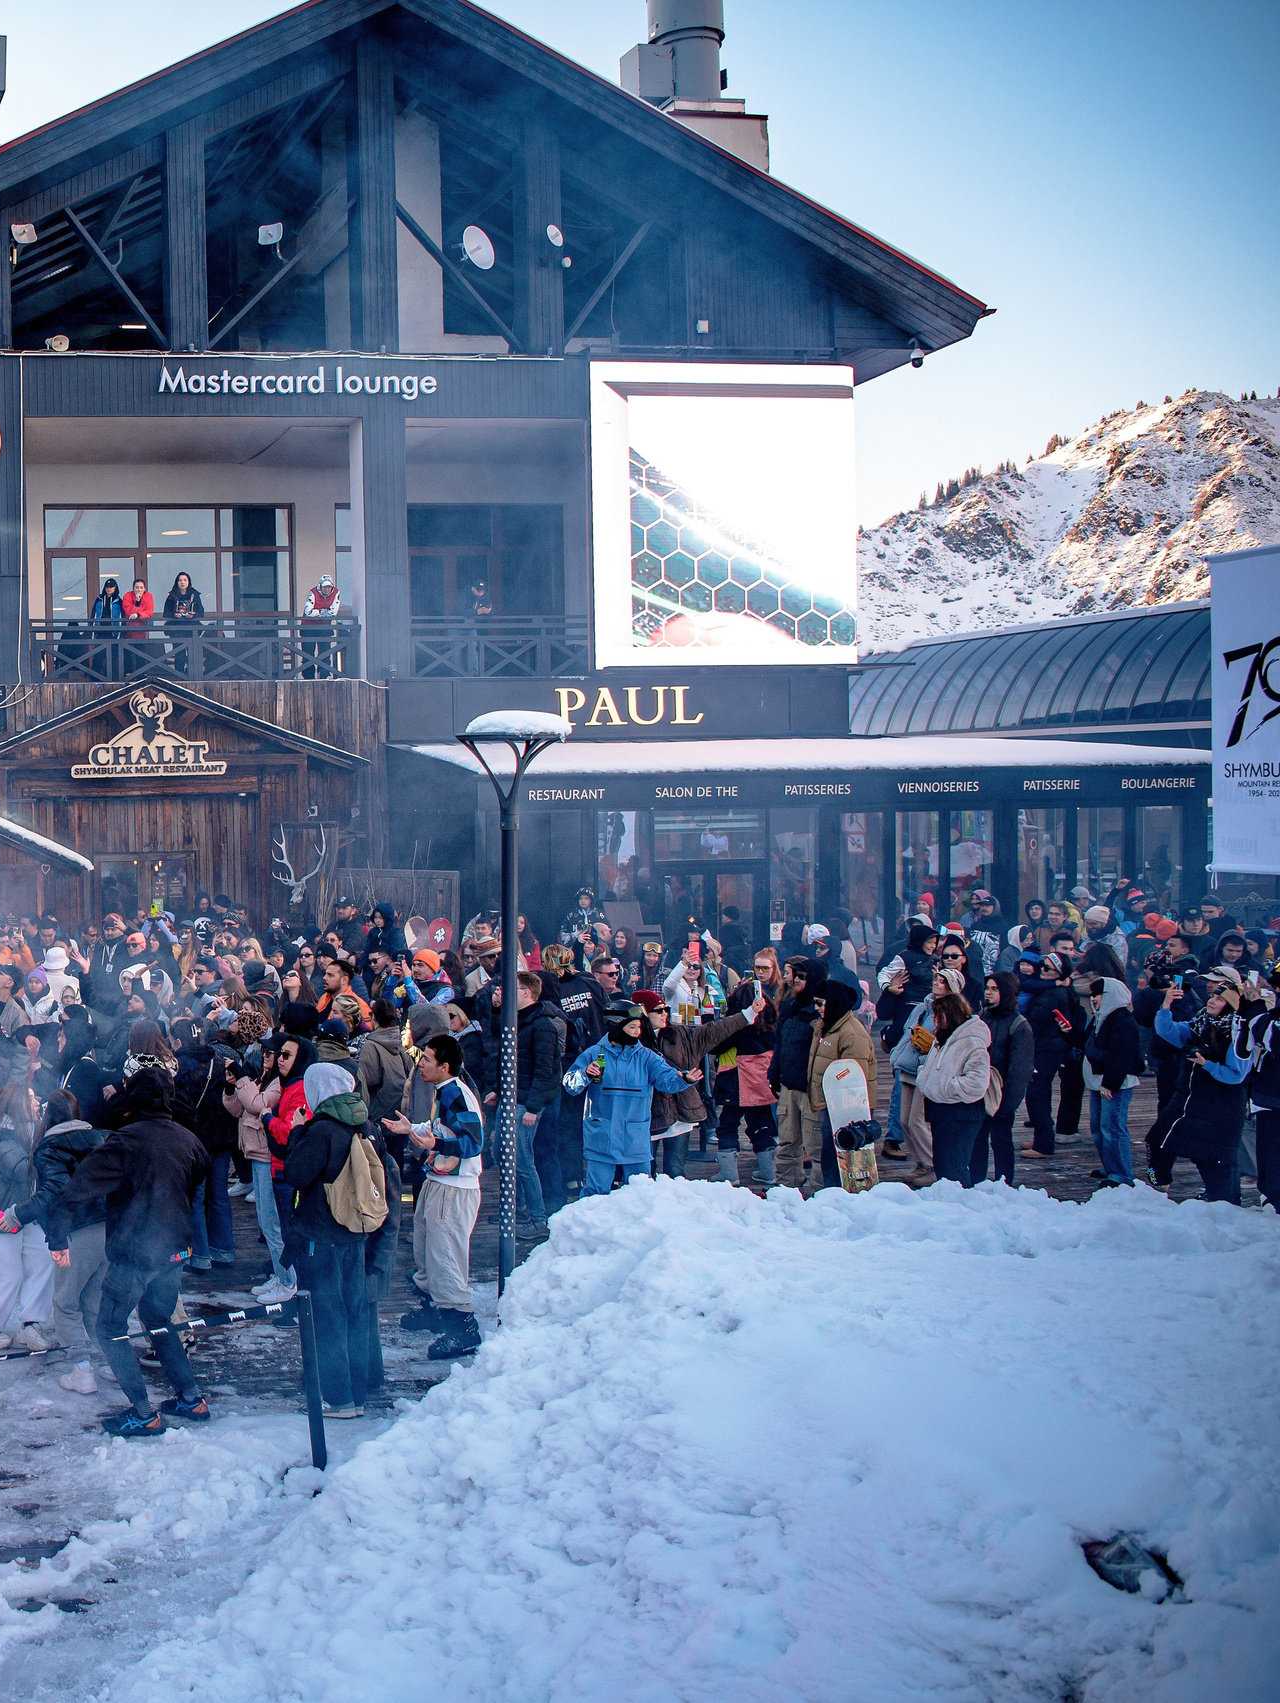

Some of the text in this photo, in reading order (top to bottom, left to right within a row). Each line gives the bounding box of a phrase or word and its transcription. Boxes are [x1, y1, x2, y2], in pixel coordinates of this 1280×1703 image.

[158, 366, 438, 401] Mastercard lounge
[554, 685, 704, 726] PAUL
[91, 744, 206, 766] CHALET
[74, 764, 224, 776] SHYMBULAK MEAT RESTAURANT
[784, 784, 851, 796] PATISSERIES
[897, 781, 980, 794] VIENNOISERIES
[1023, 779, 1081, 791] PATISSERIE
[1121, 777, 1196, 790] BOULANGERIE
[528, 788, 606, 801] RESTAURANT
[655, 786, 738, 798] SALON DE THE
[560, 992, 592, 1007] SHAPE
[563, 1000, 589, 1013] CREW
